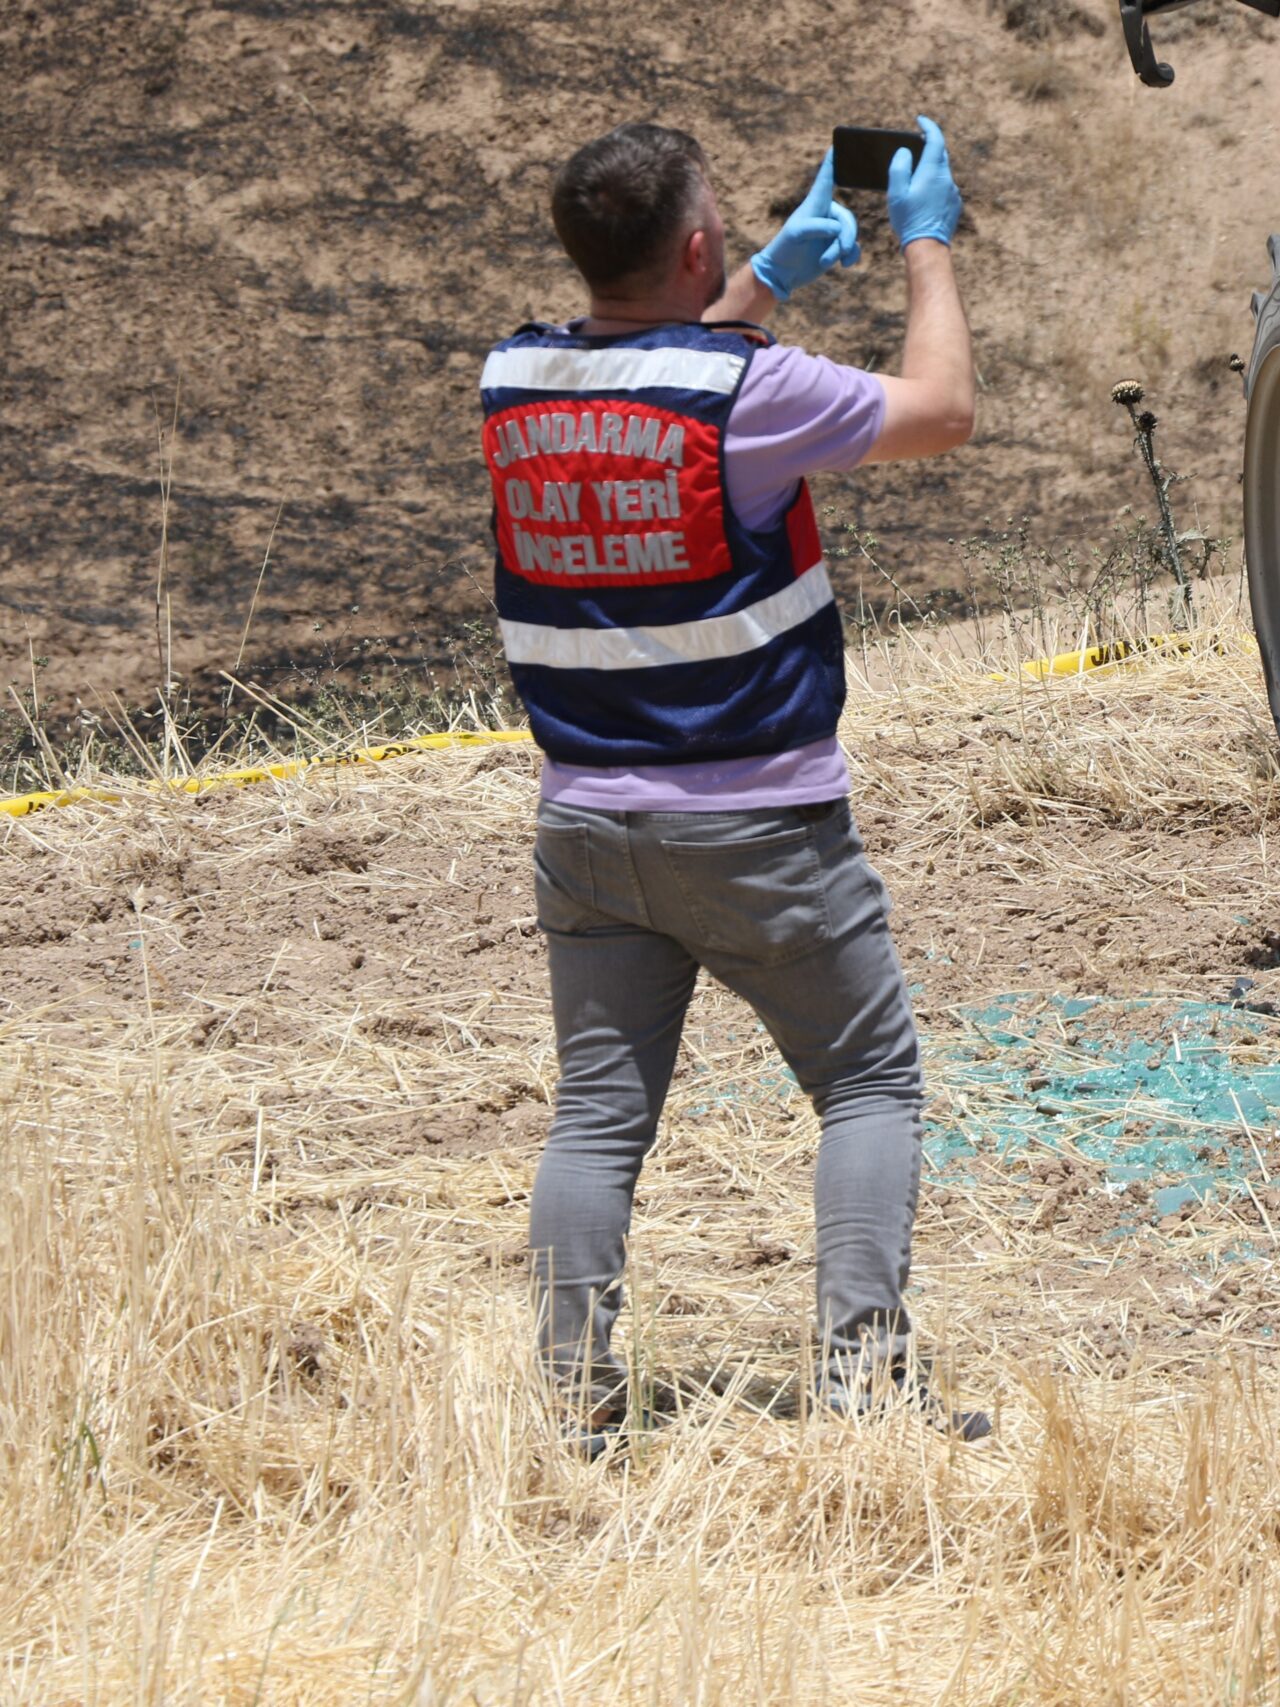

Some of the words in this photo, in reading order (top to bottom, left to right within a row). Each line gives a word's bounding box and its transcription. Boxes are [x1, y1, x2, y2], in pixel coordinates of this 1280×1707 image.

[493, 411, 685, 468] JANDARMA
[505, 478, 581, 522] OLAY
[592, 469, 681, 521] YERİ
[511, 523, 690, 575] İNCELEME
